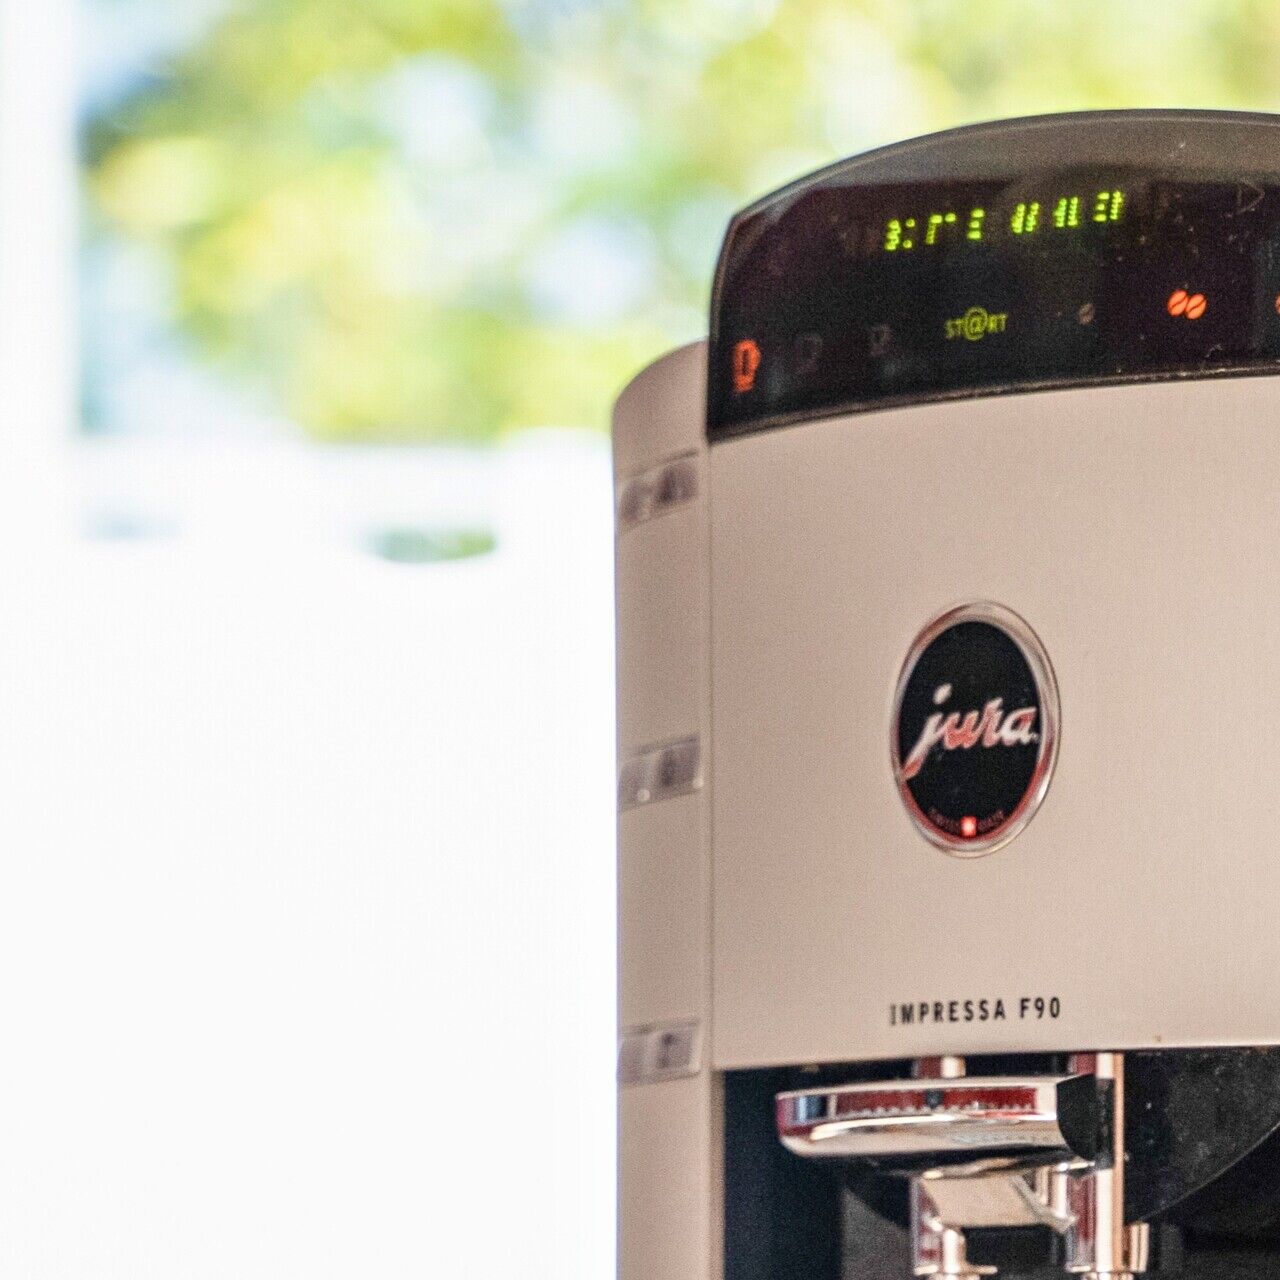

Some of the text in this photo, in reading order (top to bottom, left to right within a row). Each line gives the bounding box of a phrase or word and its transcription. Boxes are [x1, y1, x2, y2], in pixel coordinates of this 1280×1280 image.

[944, 306, 1008, 341] ST@RT
[900, 682, 1037, 782] jura
[889, 996, 1061, 1026] IMPRESSA F90
